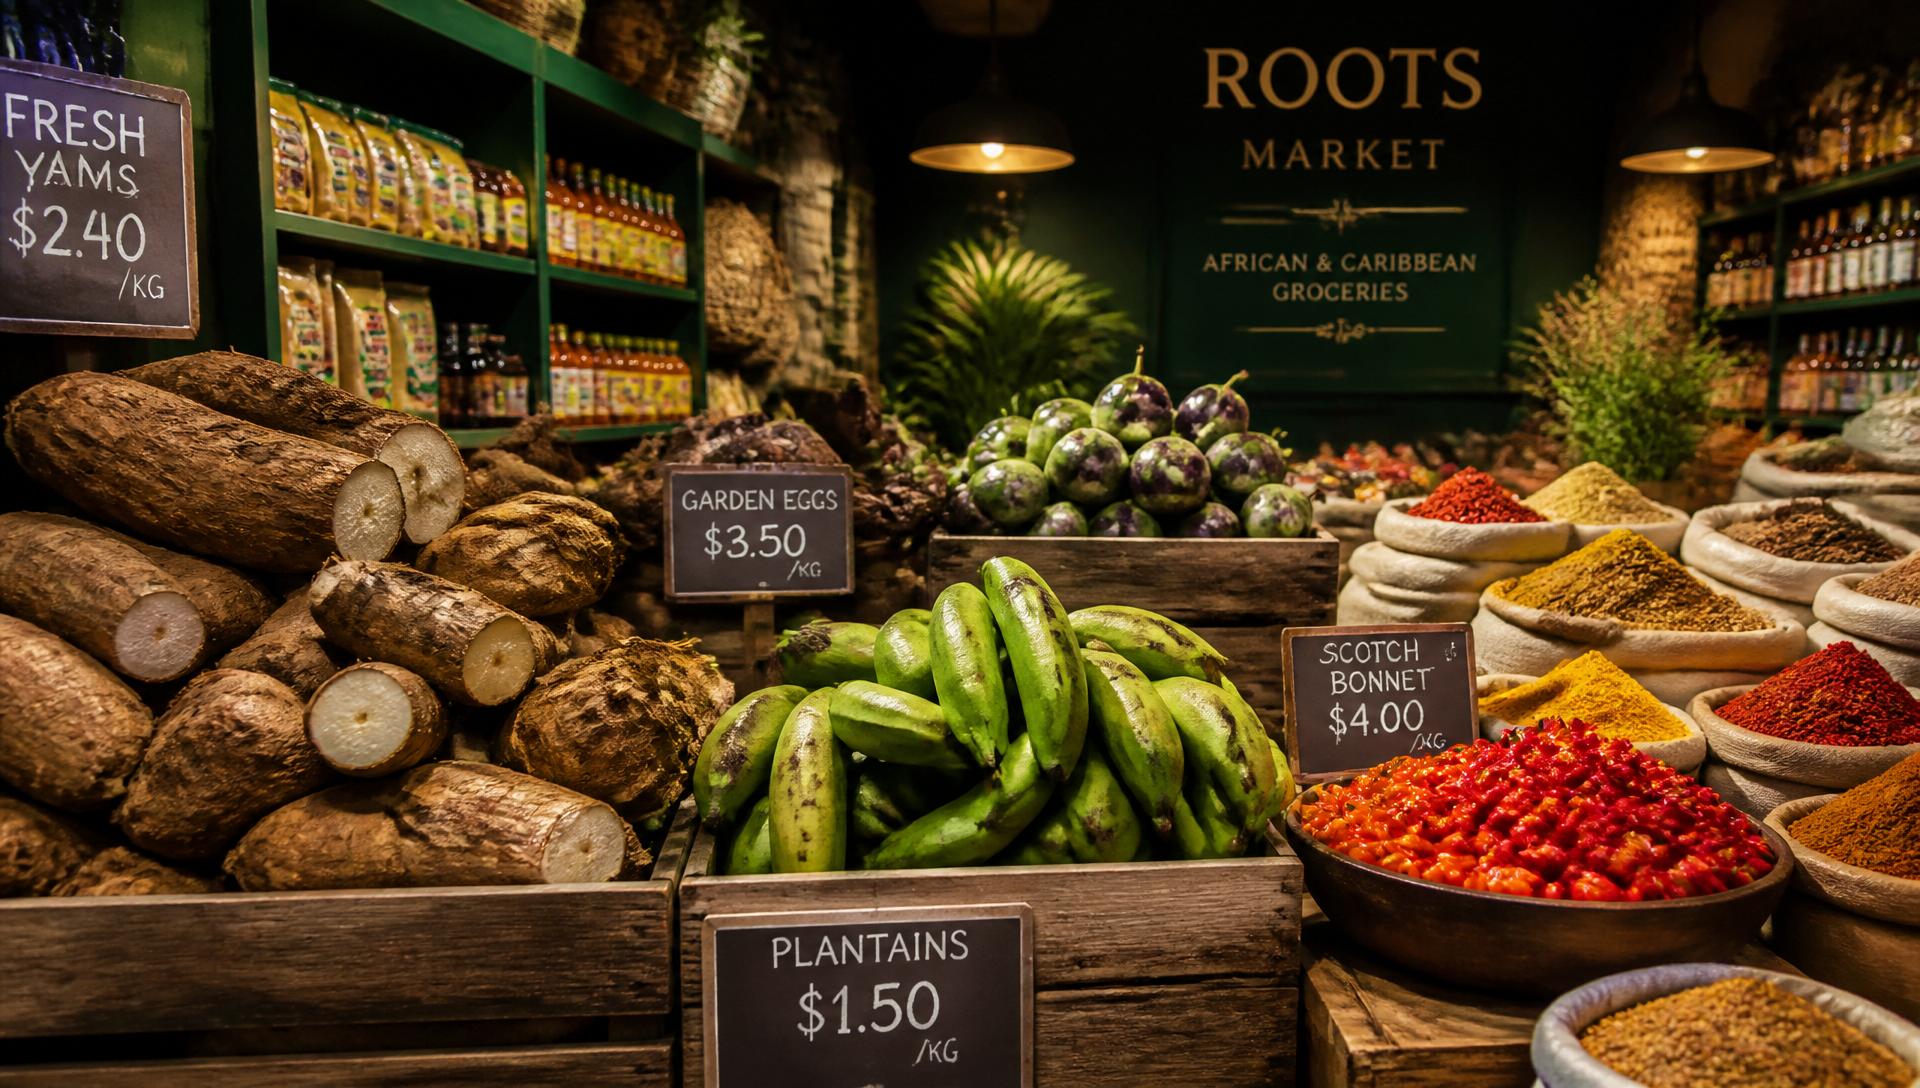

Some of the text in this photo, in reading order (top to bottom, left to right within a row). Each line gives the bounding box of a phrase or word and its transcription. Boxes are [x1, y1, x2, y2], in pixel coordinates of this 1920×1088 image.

[1202, 47, 1483, 110] ROOTS
[5, 93, 146, 157] FRESH
[1241, 138, 1445, 170] MARKET
[15, 150, 140, 199] YAMS
[8, 197, 146, 263] $2.40
[1202, 252, 1477, 273] AFRICAN & CARIBBEAN
[118, 267, 165, 301] /KG
[1272, 281, 1409, 302] GROCERIES
[681, 489, 839, 511] GARDEN EGGS
[703, 521, 807, 561] $3.50
[786, 560, 822, 581] /KG
[1319, 638, 1419, 664] SCOTCH
[1331, 666, 1436, 695] BONNET
[1328, 699, 1424, 745] $4.00
[771, 929, 969, 968] PLANTAINS
[796, 980, 940, 1042] $1.50
[911, 1037, 959, 1067] /KG
